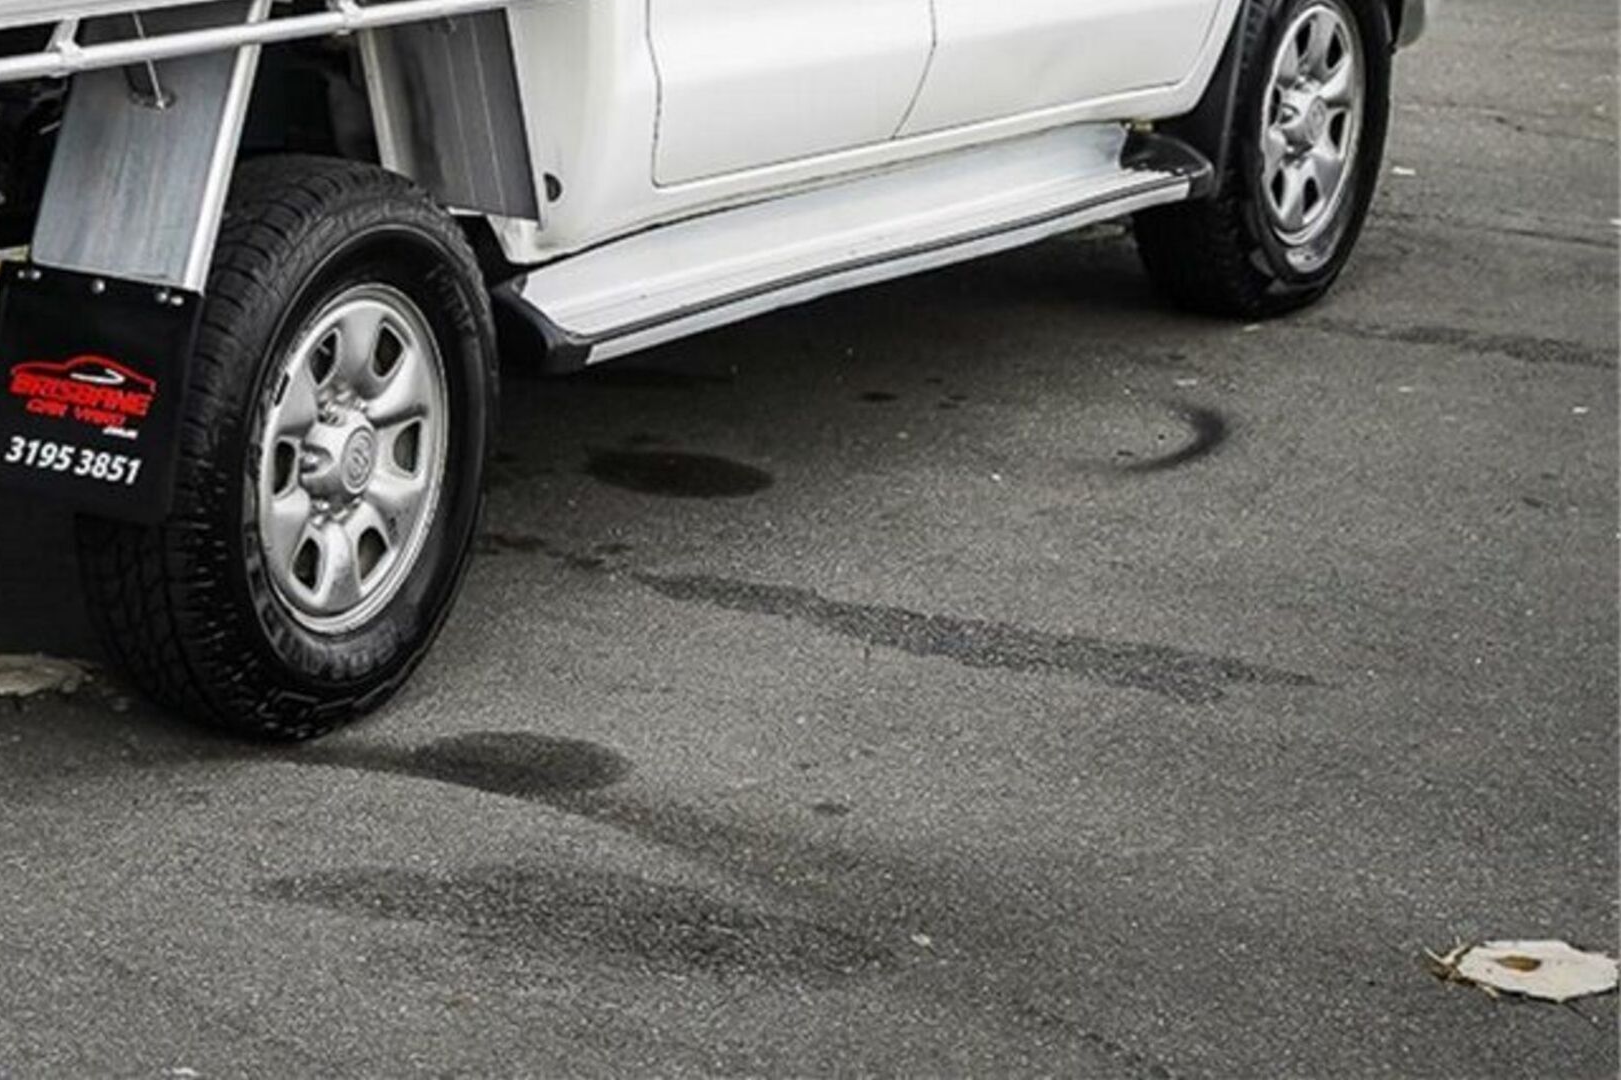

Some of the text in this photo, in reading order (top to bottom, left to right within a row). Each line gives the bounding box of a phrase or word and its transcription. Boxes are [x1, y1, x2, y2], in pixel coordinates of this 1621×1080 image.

[9, 371, 153, 416] BRISBANE
[4, 435, 142, 485] 3195 3851
